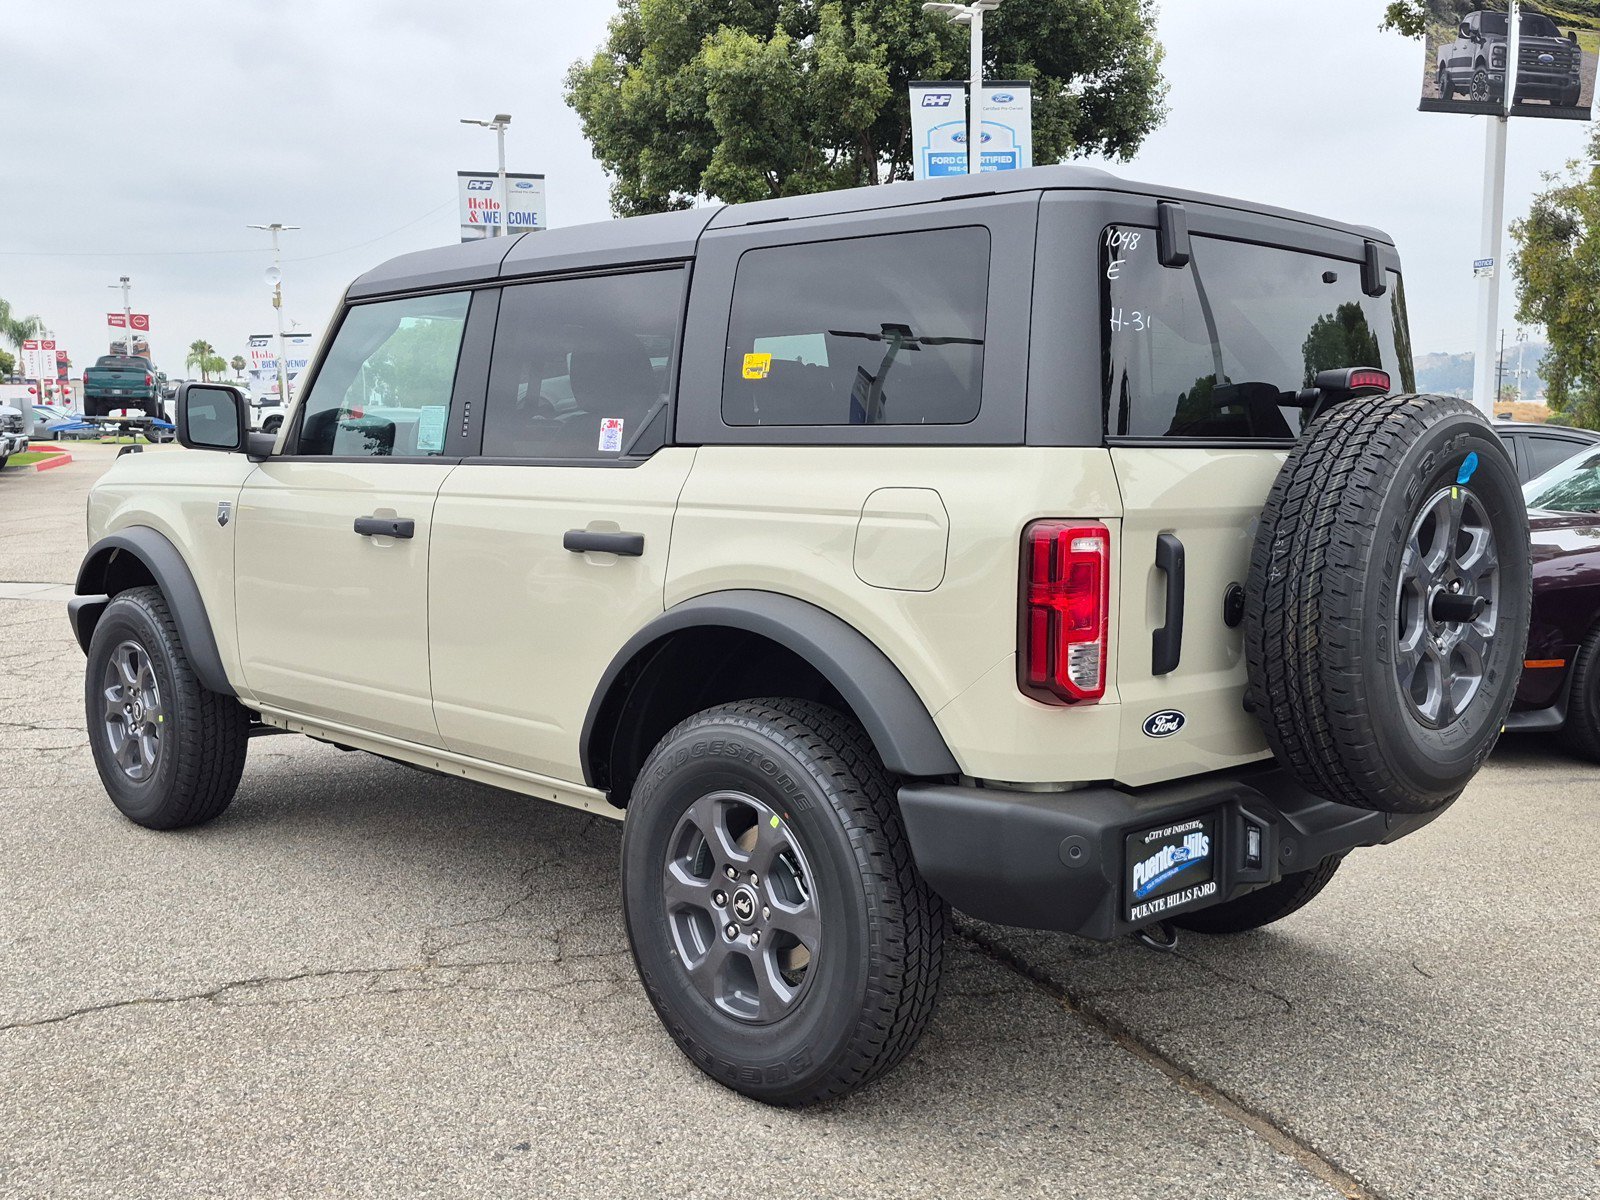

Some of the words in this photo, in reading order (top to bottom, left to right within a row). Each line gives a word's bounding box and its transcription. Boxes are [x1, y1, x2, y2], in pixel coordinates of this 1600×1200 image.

[931, 156, 956, 165] FORD
[468, 197, 500, 210] Hello
[468, 210, 479, 223] &
[1106, 229, 1141, 250] 1048
[1106, 259, 1126, 280] E
[251, 350, 274, 359] Hola
[606, 419, 619, 429] 3M
[1148, 830, 1163, 841] CITY
[1163, 827, 1172, 837] OF
[1172, 820, 1200, 834] INDUSTRY
[1132, 845, 1175, 892] Puente
[1183, 831, 1209, 860] Hills
[1131, 897, 1166, 920] PUENTE
[1166, 889, 1192, 908] HILLS
[1193, 881, 1217, 899] FORD
